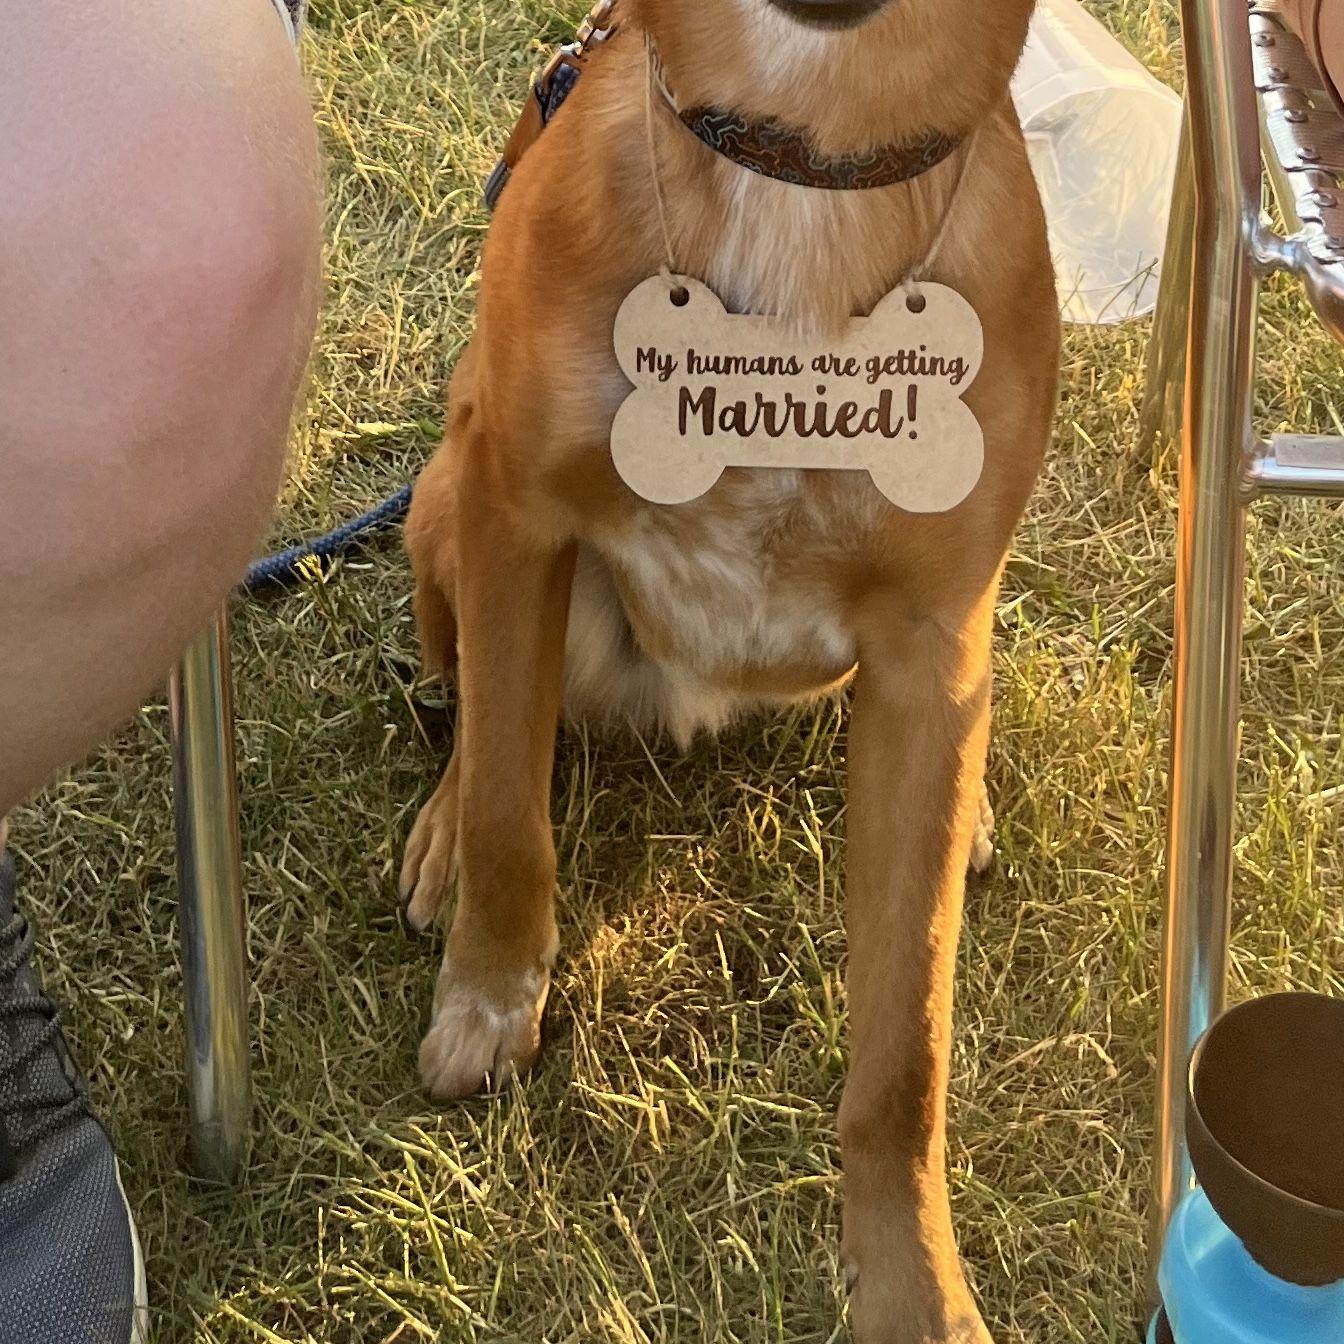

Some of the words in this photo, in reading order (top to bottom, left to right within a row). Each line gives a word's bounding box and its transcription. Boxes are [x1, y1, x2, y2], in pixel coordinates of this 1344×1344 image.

[636, 346, 678, 382] My
[686, 348, 804, 376] humans
[811, 352, 861, 377] are
[865, 344, 970, 385] getting
[678, 384, 919, 440] Married!
